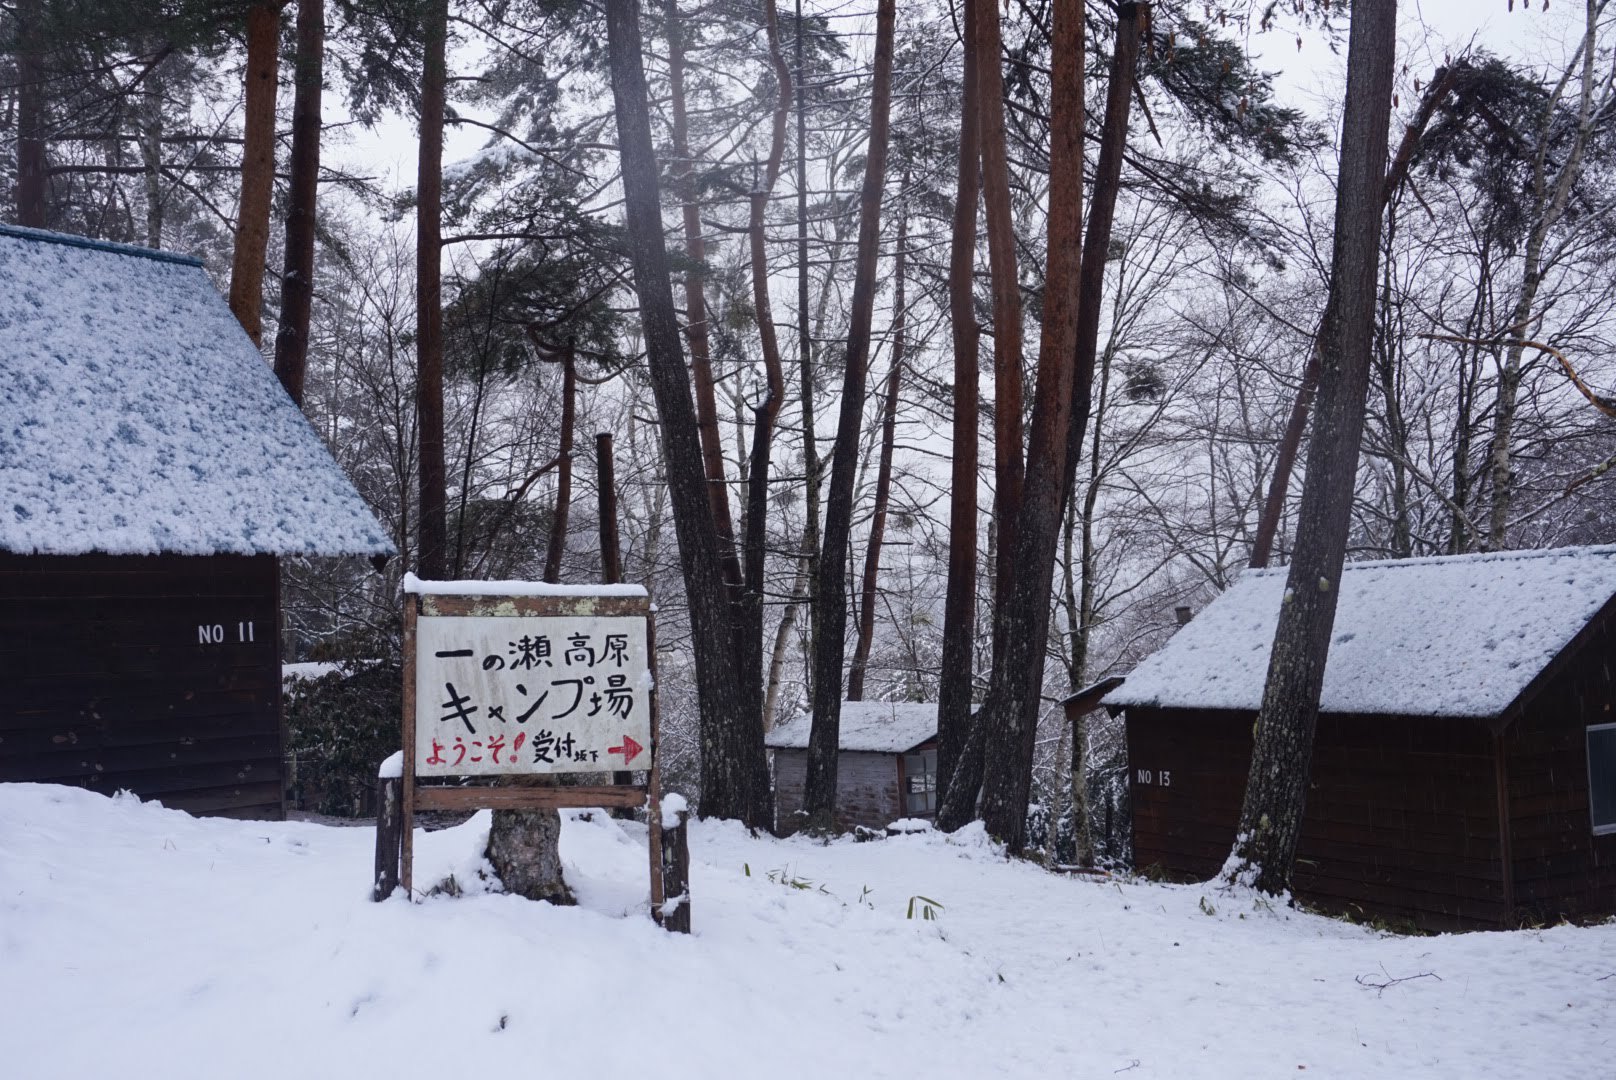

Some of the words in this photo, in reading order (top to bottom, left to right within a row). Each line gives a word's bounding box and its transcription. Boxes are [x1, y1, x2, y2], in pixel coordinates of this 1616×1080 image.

[198, 624, 224, 644] NO
[238, 621, 254, 642] 11
[440, 674, 634, 734] キャンプ場
[1137, 769, 1152, 784] NO
[1159, 770, 1171, 787] 13
